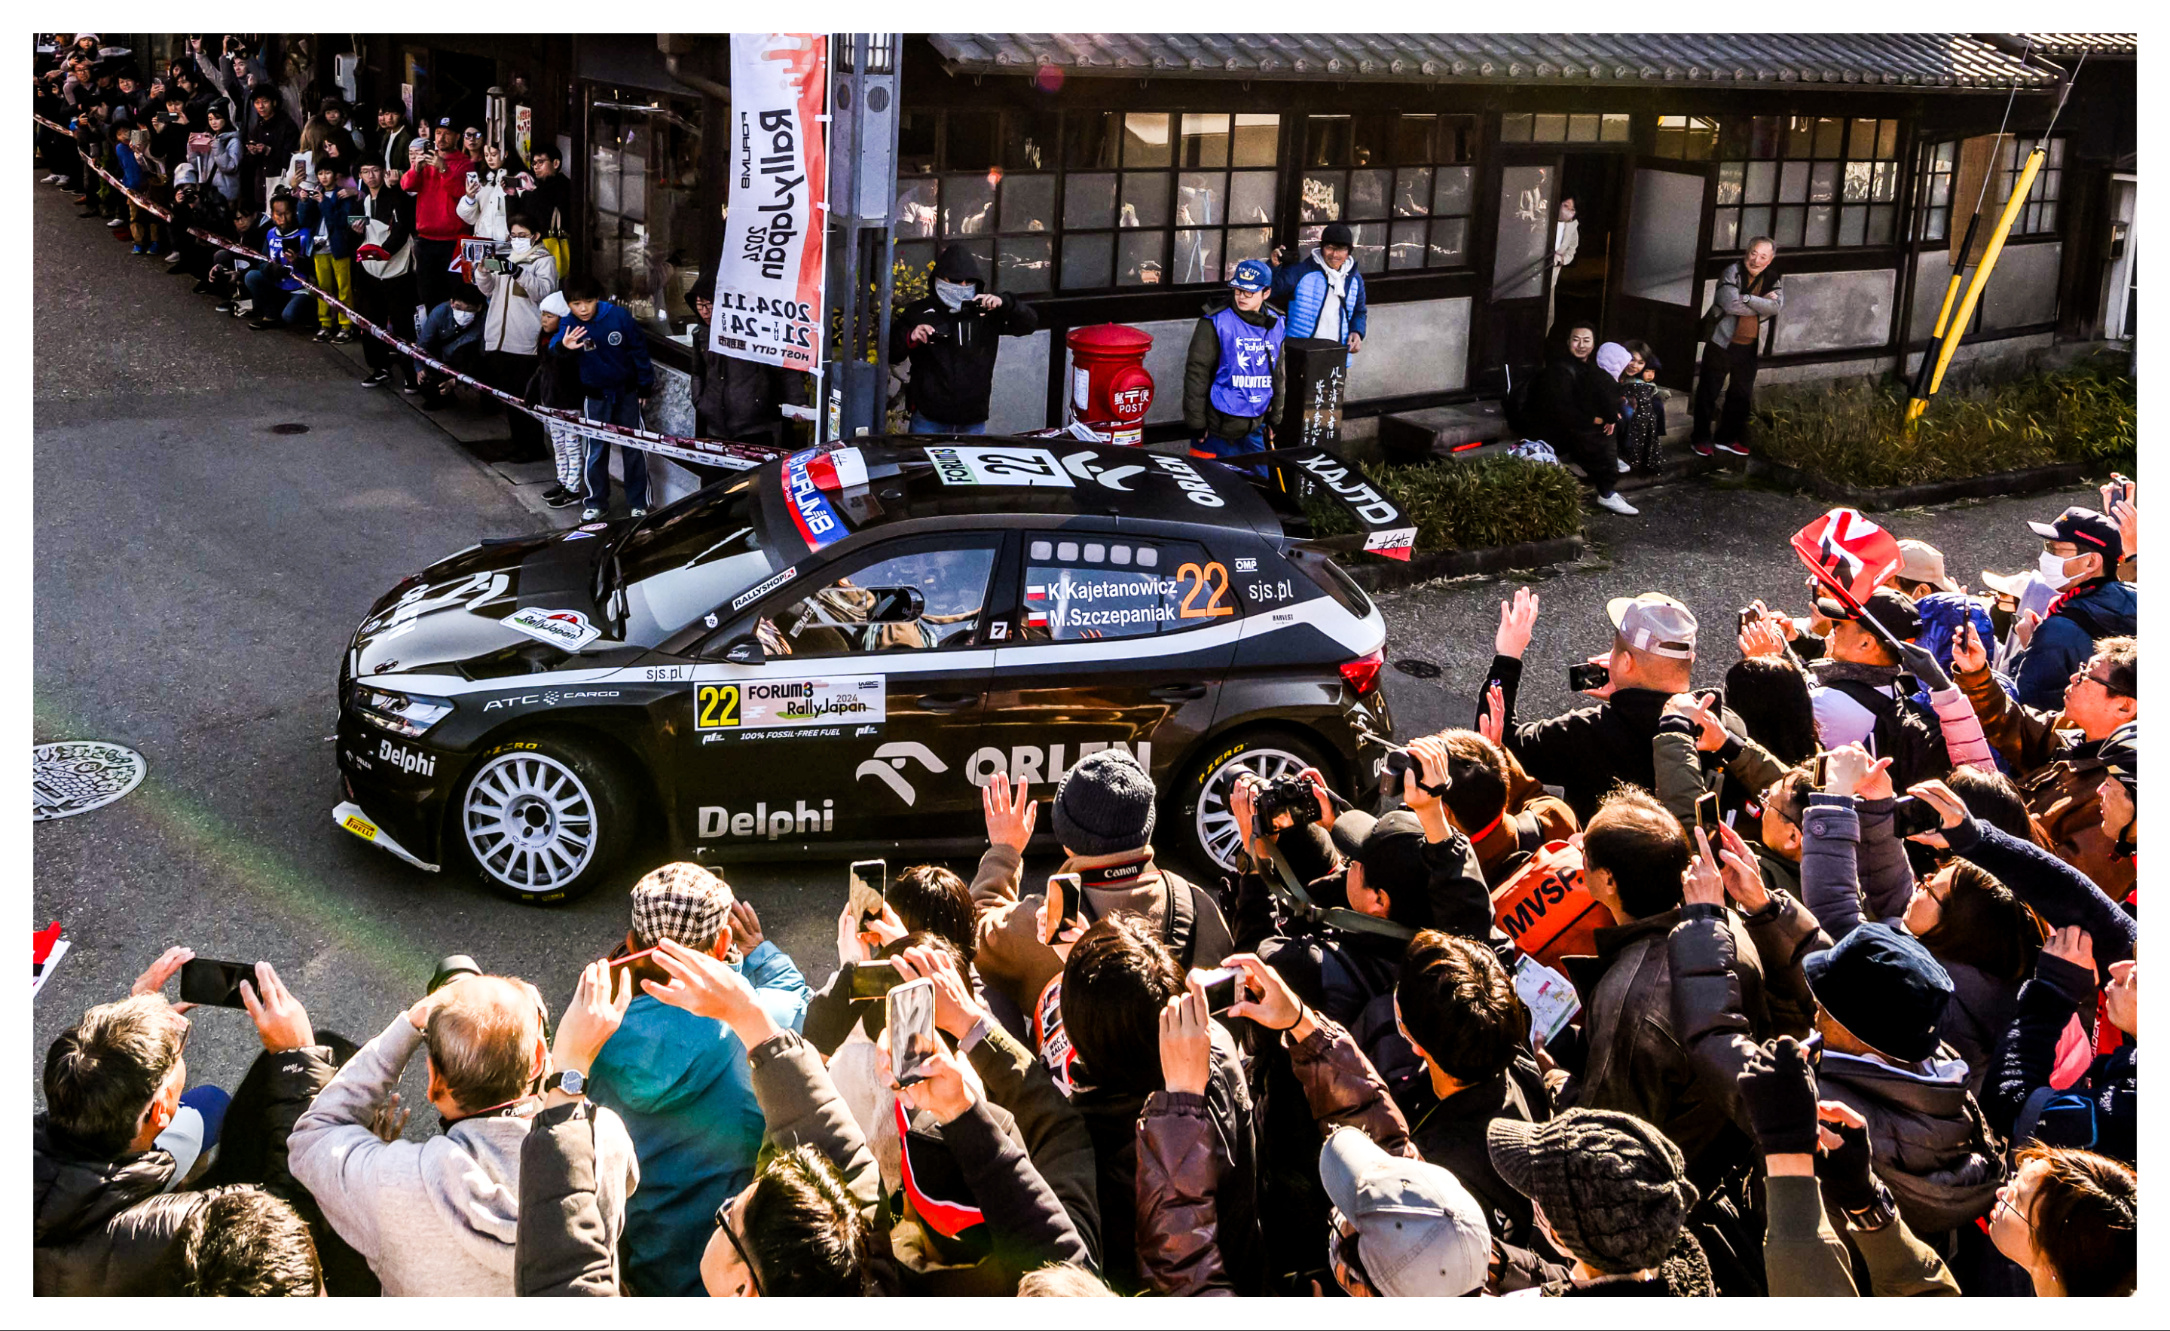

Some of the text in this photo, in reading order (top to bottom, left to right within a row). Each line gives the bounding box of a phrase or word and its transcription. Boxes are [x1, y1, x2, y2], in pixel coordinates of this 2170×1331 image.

[1118, 403, 1144, 413] POST
[977, 454, 1056, 476] 22
[1148, 454, 1225, 507] ORLEN
[1235, 559, 1258, 571] OMP
[1048, 577, 1178, 604] K.Kajetanowicz
[1176, 561, 1234, 619] 22
[1248, 579, 1294, 602] sjs.pl
[1050, 604, 1176, 628] M.Szczepaniak
[646, 665, 683, 682] sjs.pl
[483, 690, 620, 712] ATC CARGO
[749, 681, 814, 699] FORUM8
[836, 694, 858, 703] 2024
[699, 685, 740, 727] 22
[787, 698, 867, 718] RallyJapan
[740, 728, 841, 740] 100% FOSSIL-FREE FUEL
[379, 739, 437, 777] Delphi
[965, 741, 1152, 787] ORLN
[1207, 743, 1245, 775] ZERO
[346, 817, 376, 838] PIRELLI
[698, 798, 834, 841] Delphi
[1103, 863, 1139, 880] Canon
[1050, 1040, 1069, 1058] RALLY
